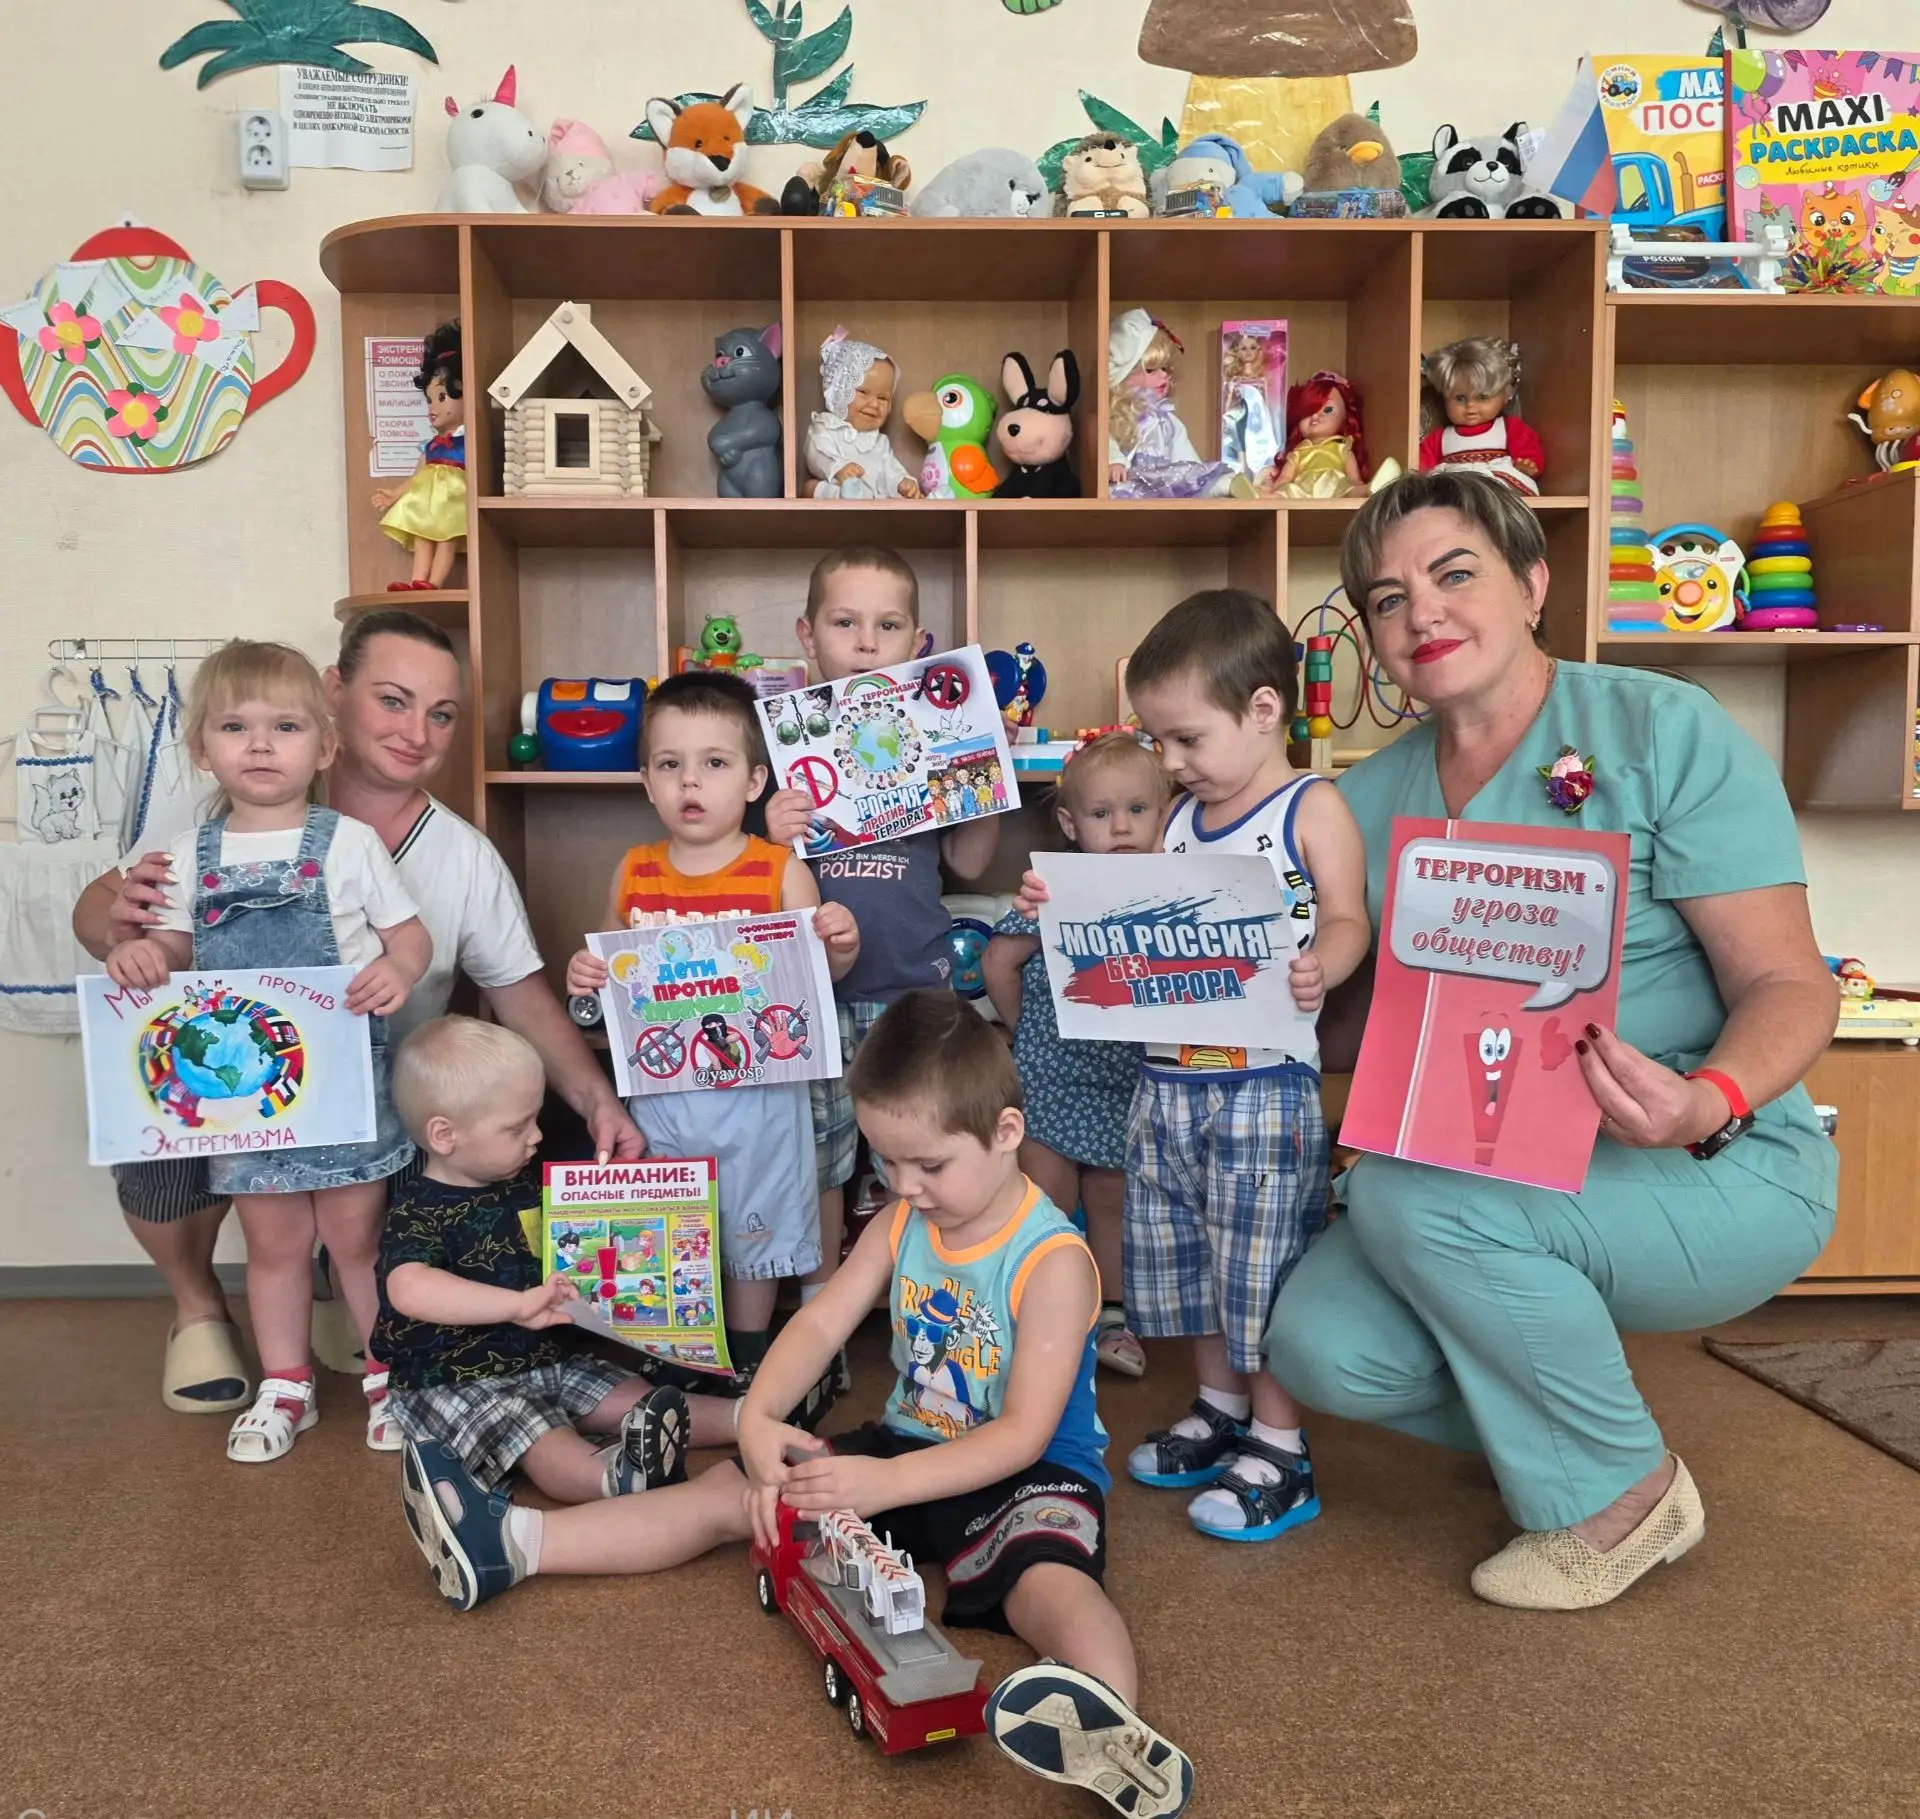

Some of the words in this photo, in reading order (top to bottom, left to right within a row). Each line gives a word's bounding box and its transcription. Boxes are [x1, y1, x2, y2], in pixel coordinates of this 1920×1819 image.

[297, 67, 350, 81] УВАЖАЕМЫЕ
[352, 72, 409, 87] СОТРУДНИКИ!
[327, 101, 337, 110] НЕ
[338, 101, 378, 114] ВКЛЮЧАТЬ
[1777, 94, 1884, 133] MAXI
[1750, 129, 1918, 164] РАСКРАСКА
[1837, 161, 1880, 173] котики
[378, 355, 421, 365] ПОМОЩЬ
[379, 370, 385, 378] О
[379, 399, 422, 408] МИЛИЦИЯ
[380, 420, 414, 428] СКОРАЯ
[380, 430, 420, 438] ПОМОЩЬ
[855, 785, 922, 820] РОССИЯ
[863, 804, 906, 833] ПРОТИВ
[873, 808, 925, 840] ТЕРРОРА!
[820, 861, 907, 880] POLIZIST
[871, 853, 897, 861] WERDE
[898, 856, 910, 865] ICH
[1415, 857, 1586, 895] ТЕРРОРИЗМ
[1452, 896, 1559, 927] угроза
[1060, 922, 1129, 957] МОЯ
[1133, 922, 1270, 959] РОССИЯ
[1412, 926, 1586, 976] обществу!
[1104, 953, 1149, 982] БЕЗ
[653, 976, 740, 1002] ПРОТИВ
[1128, 968, 1246, 1007] ТЕРРОРА
[693, 1065, 765, 1087] @yavosp
[564, 1167, 696, 1187] ВНИМАНИЕ:
[561, 1189, 625, 1201] ОПАСНЫЕ
[631, 1187, 701, 1200] ПРЕДМЕТЫ!
[974, 1511, 1025, 1570] SUPPORTS
